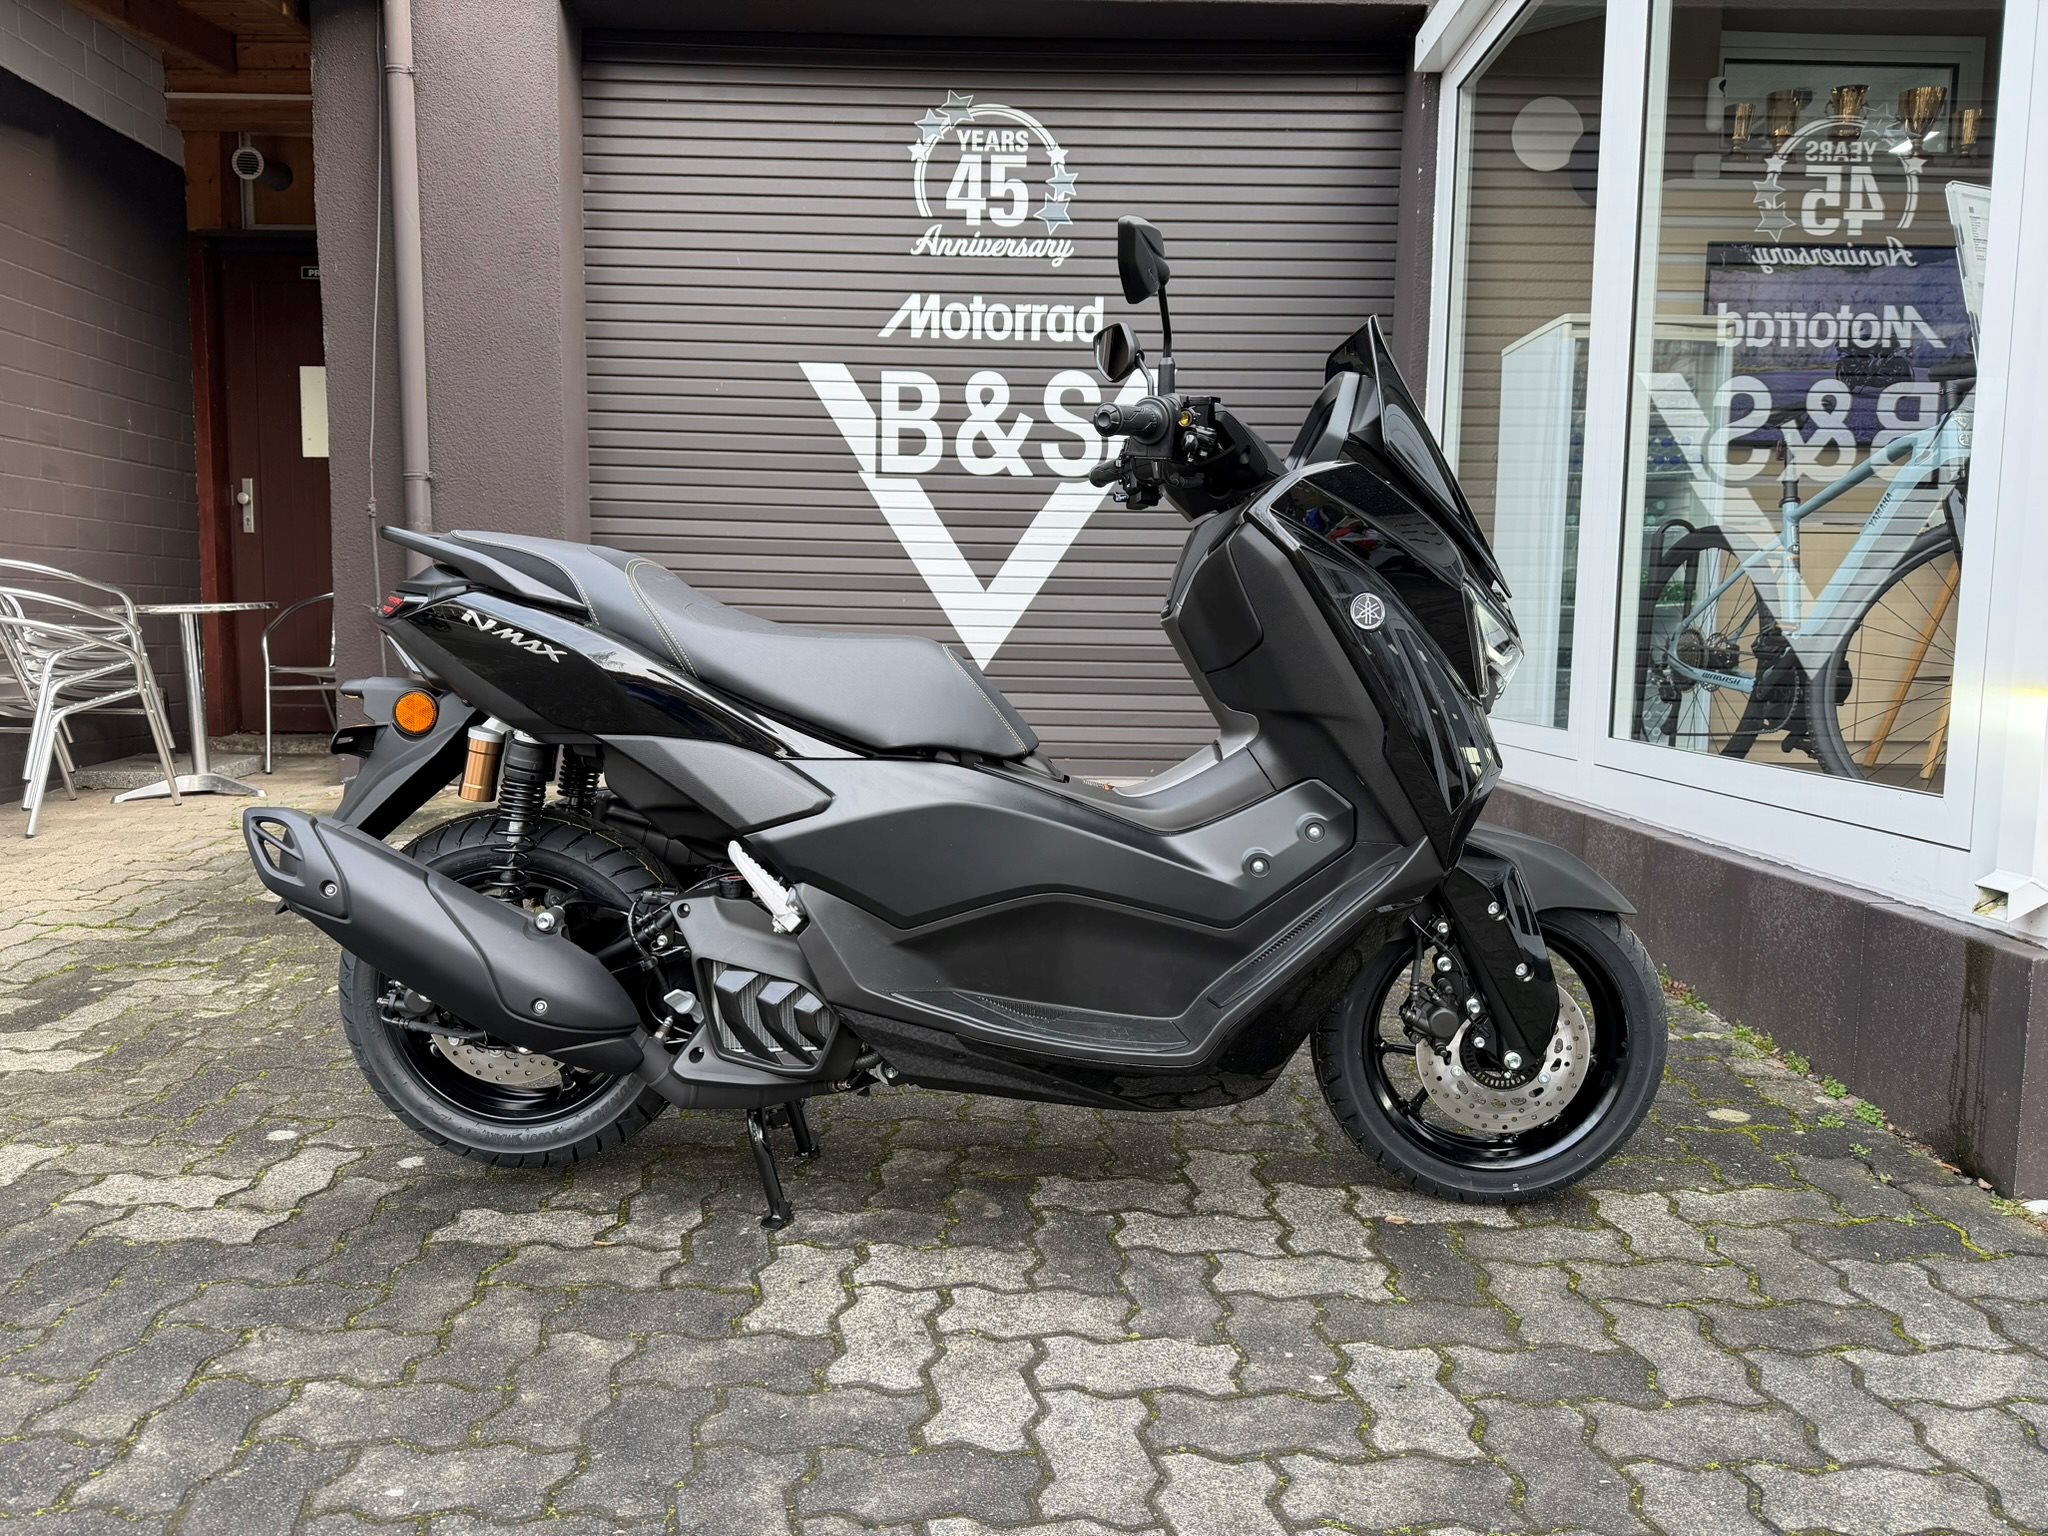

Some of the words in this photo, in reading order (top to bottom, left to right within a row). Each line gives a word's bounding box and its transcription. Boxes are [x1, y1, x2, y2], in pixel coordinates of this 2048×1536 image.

[956, 129, 1029, 152] YEARS
[944, 154, 1029, 228] 45
[909, 223, 1075, 267] Anniversary
[877, 292, 1105, 343] Motorrad
[1868, 492, 1893, 527] YAMAHA
[461, 609, 568, 664] NMAX
[1703, 672, 1741, 685] WABASH
